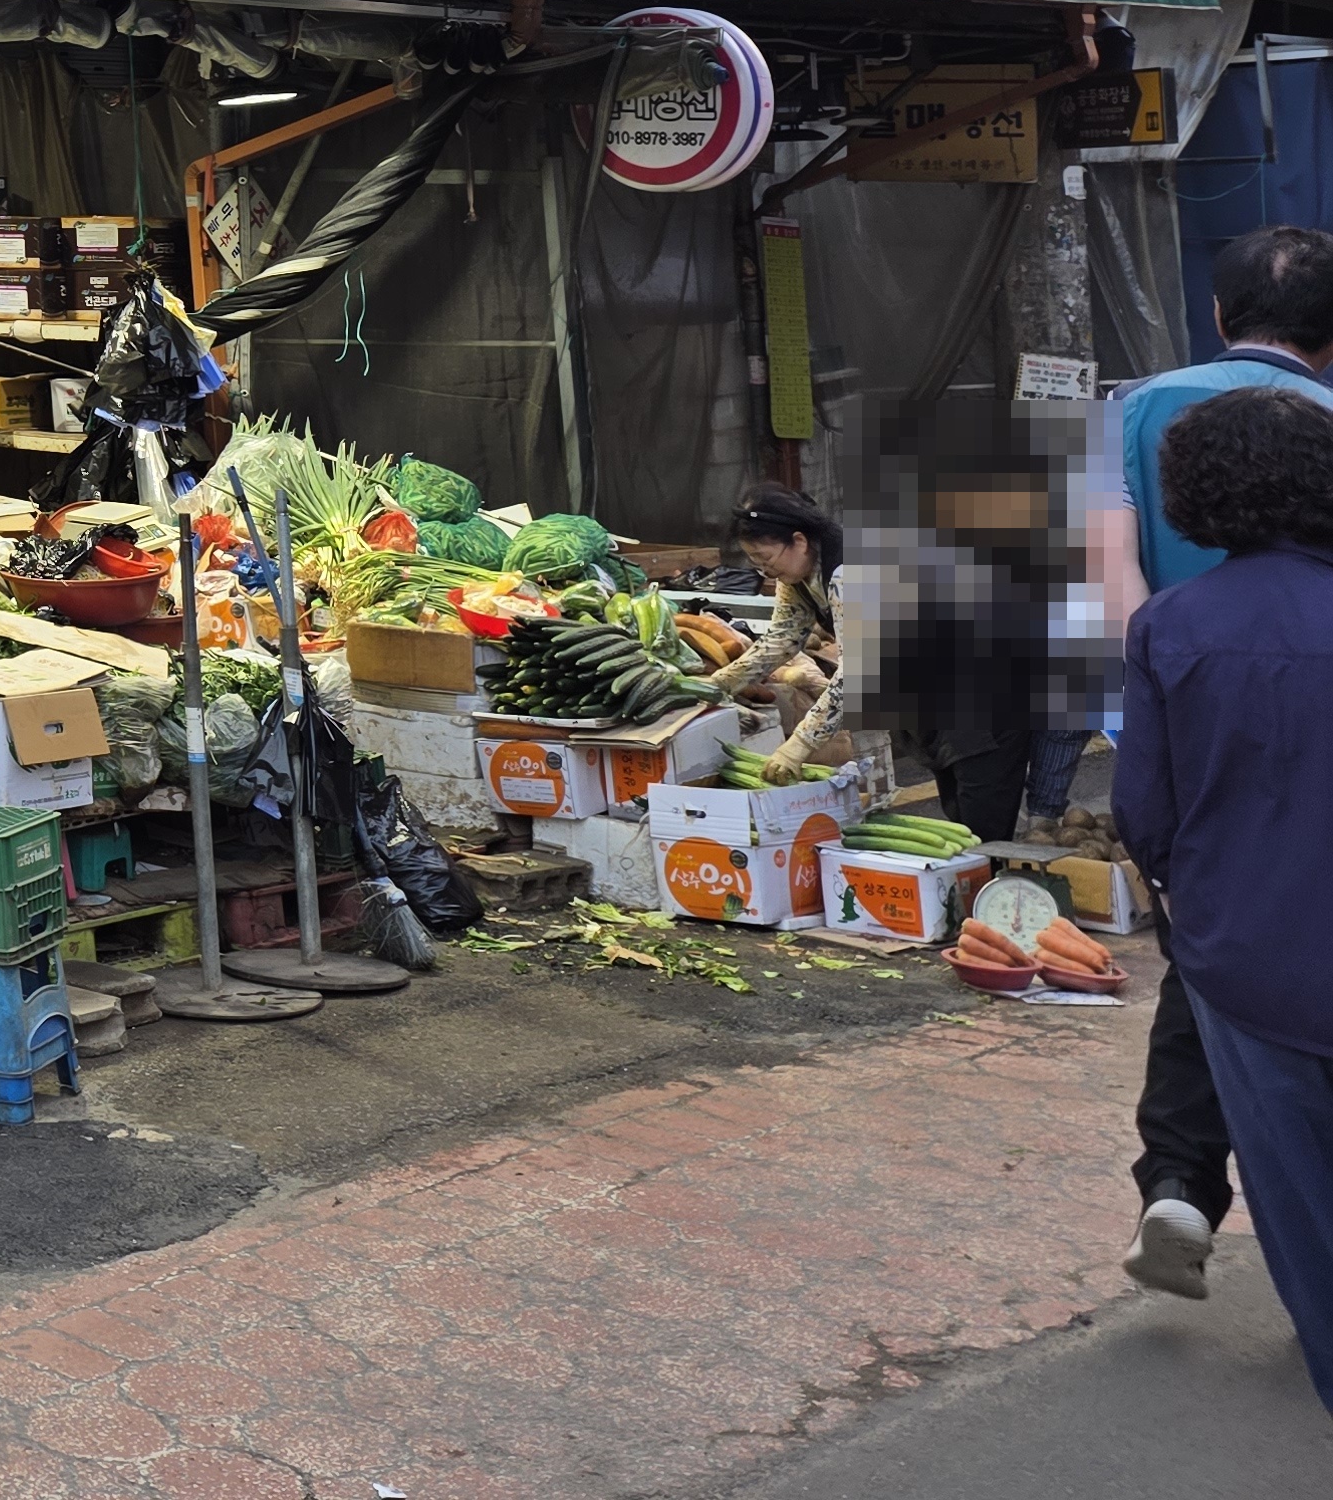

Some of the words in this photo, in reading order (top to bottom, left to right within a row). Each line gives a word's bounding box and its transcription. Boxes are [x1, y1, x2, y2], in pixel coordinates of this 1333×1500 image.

[611, 88, 717, 121] 매생선
[607, 131, 706, 146] 010-8978-3987
[670, 863, 745, 895] 상주오이
[863, 882, 915, 901] 상주오이
